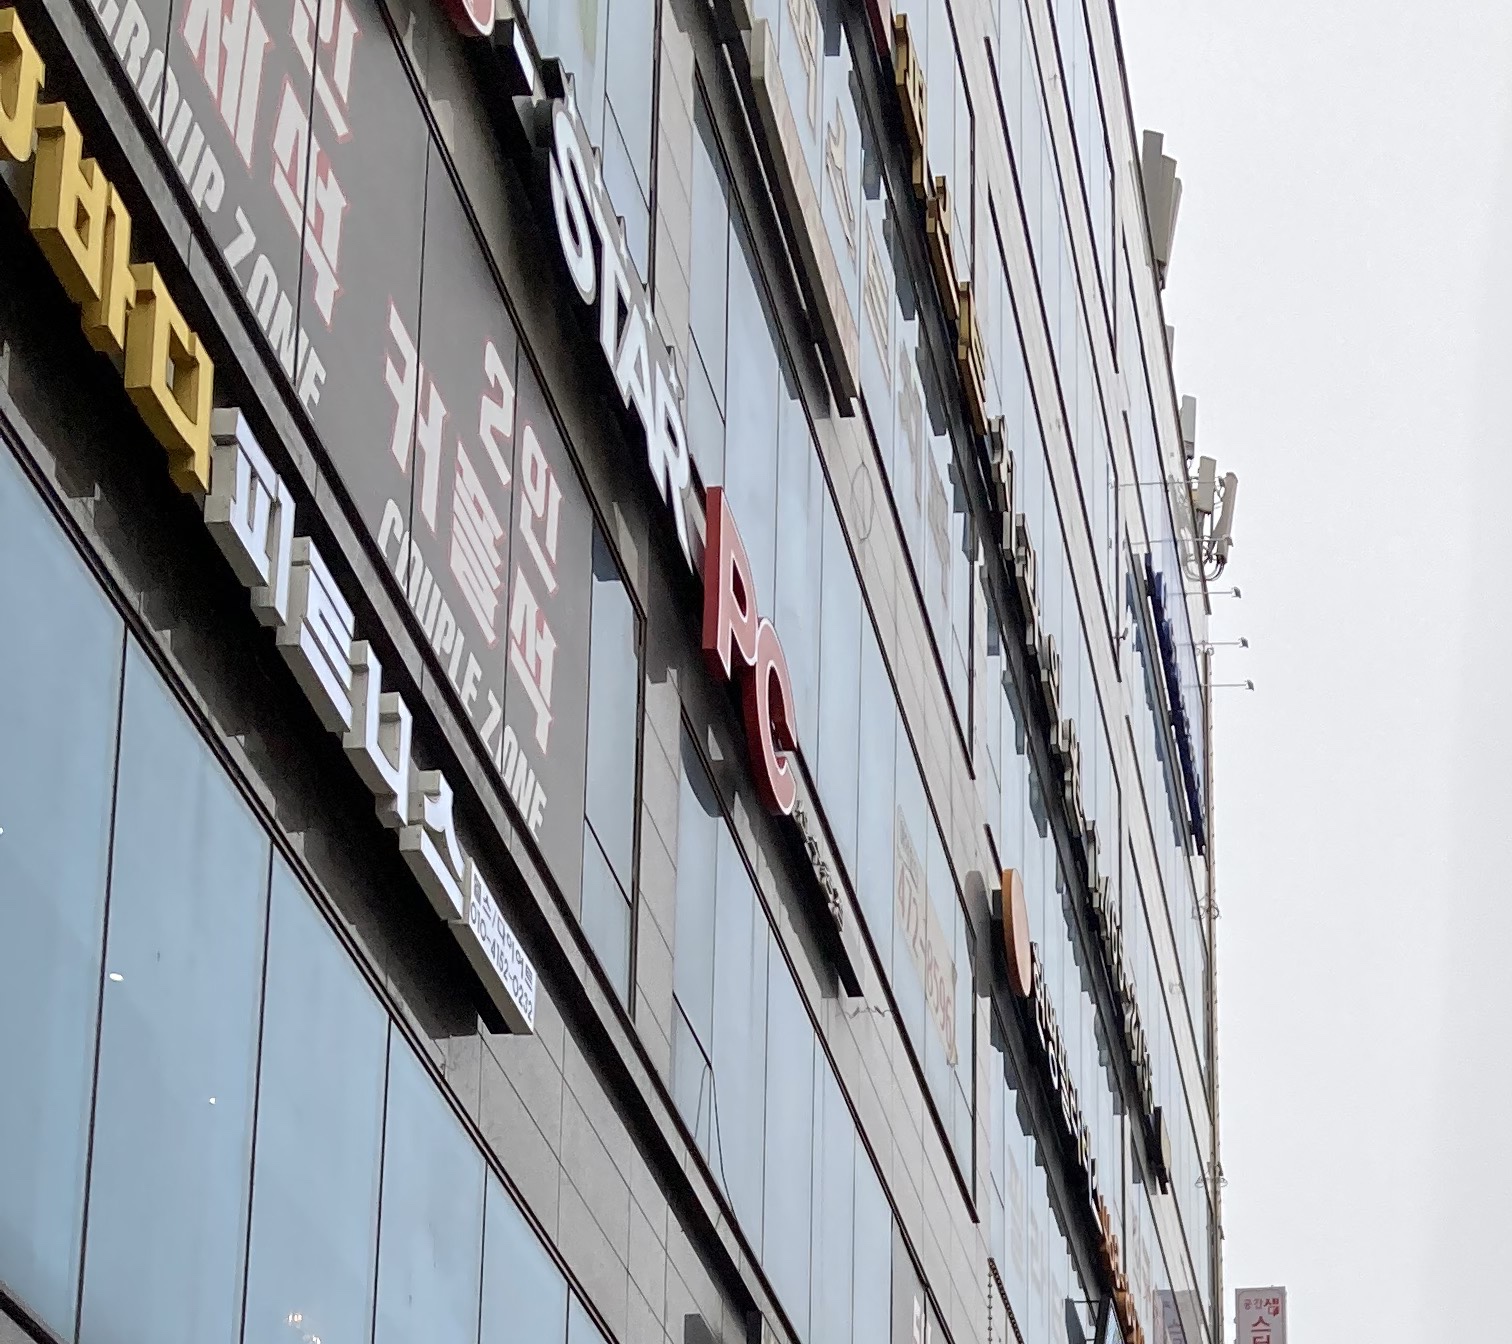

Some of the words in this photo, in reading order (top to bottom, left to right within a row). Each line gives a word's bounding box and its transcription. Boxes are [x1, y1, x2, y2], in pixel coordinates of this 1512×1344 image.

[223, 205, 327, 421] ZONE
[549, 100, 698, 574] STAR
[703, 486, 798, 816] PC
[224, 406, 466, 920] 피트니스
[377, 498, 483, 718] COUPLE
[479, 688, 548, 843] ZONE
